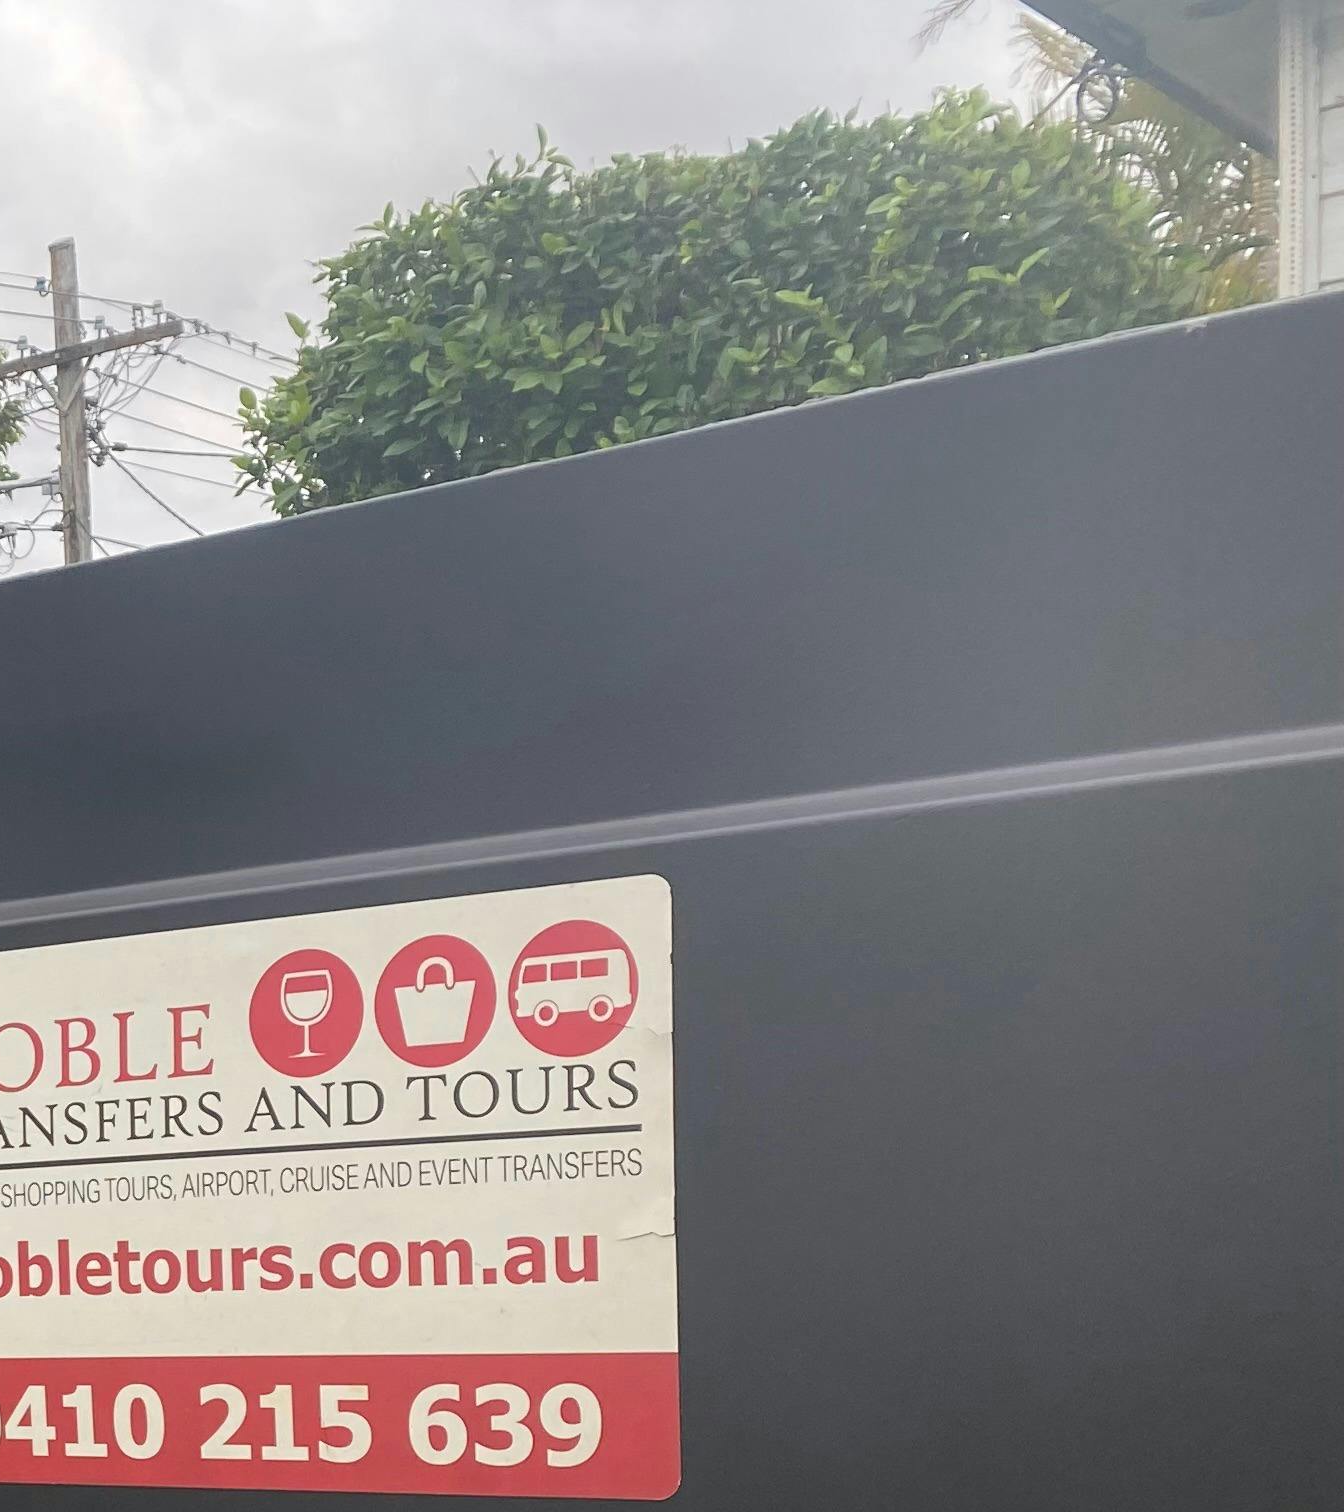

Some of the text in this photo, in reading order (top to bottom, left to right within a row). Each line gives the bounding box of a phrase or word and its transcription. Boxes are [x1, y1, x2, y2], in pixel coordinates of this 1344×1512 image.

[244, 1080, 386, 1134] AND
[406, 1059, 640, 1122] TOURS
[0, 1177, 101, 1209] SHOPPING
[104, 1173, 177, 1204] TOURS,
[182, 1168, 275, 1200] AIRPORT,
[279, 1163, 359, 1194] CRUISE
[363, 1160, 413, 1191] AND
[417, 1155, 493, 1187] EVENT
[496, 1148, 643, 1183] TRANSFERS
[199, 1383, 373, 1462] 215
[408, 1381, 604, 1468] 639
